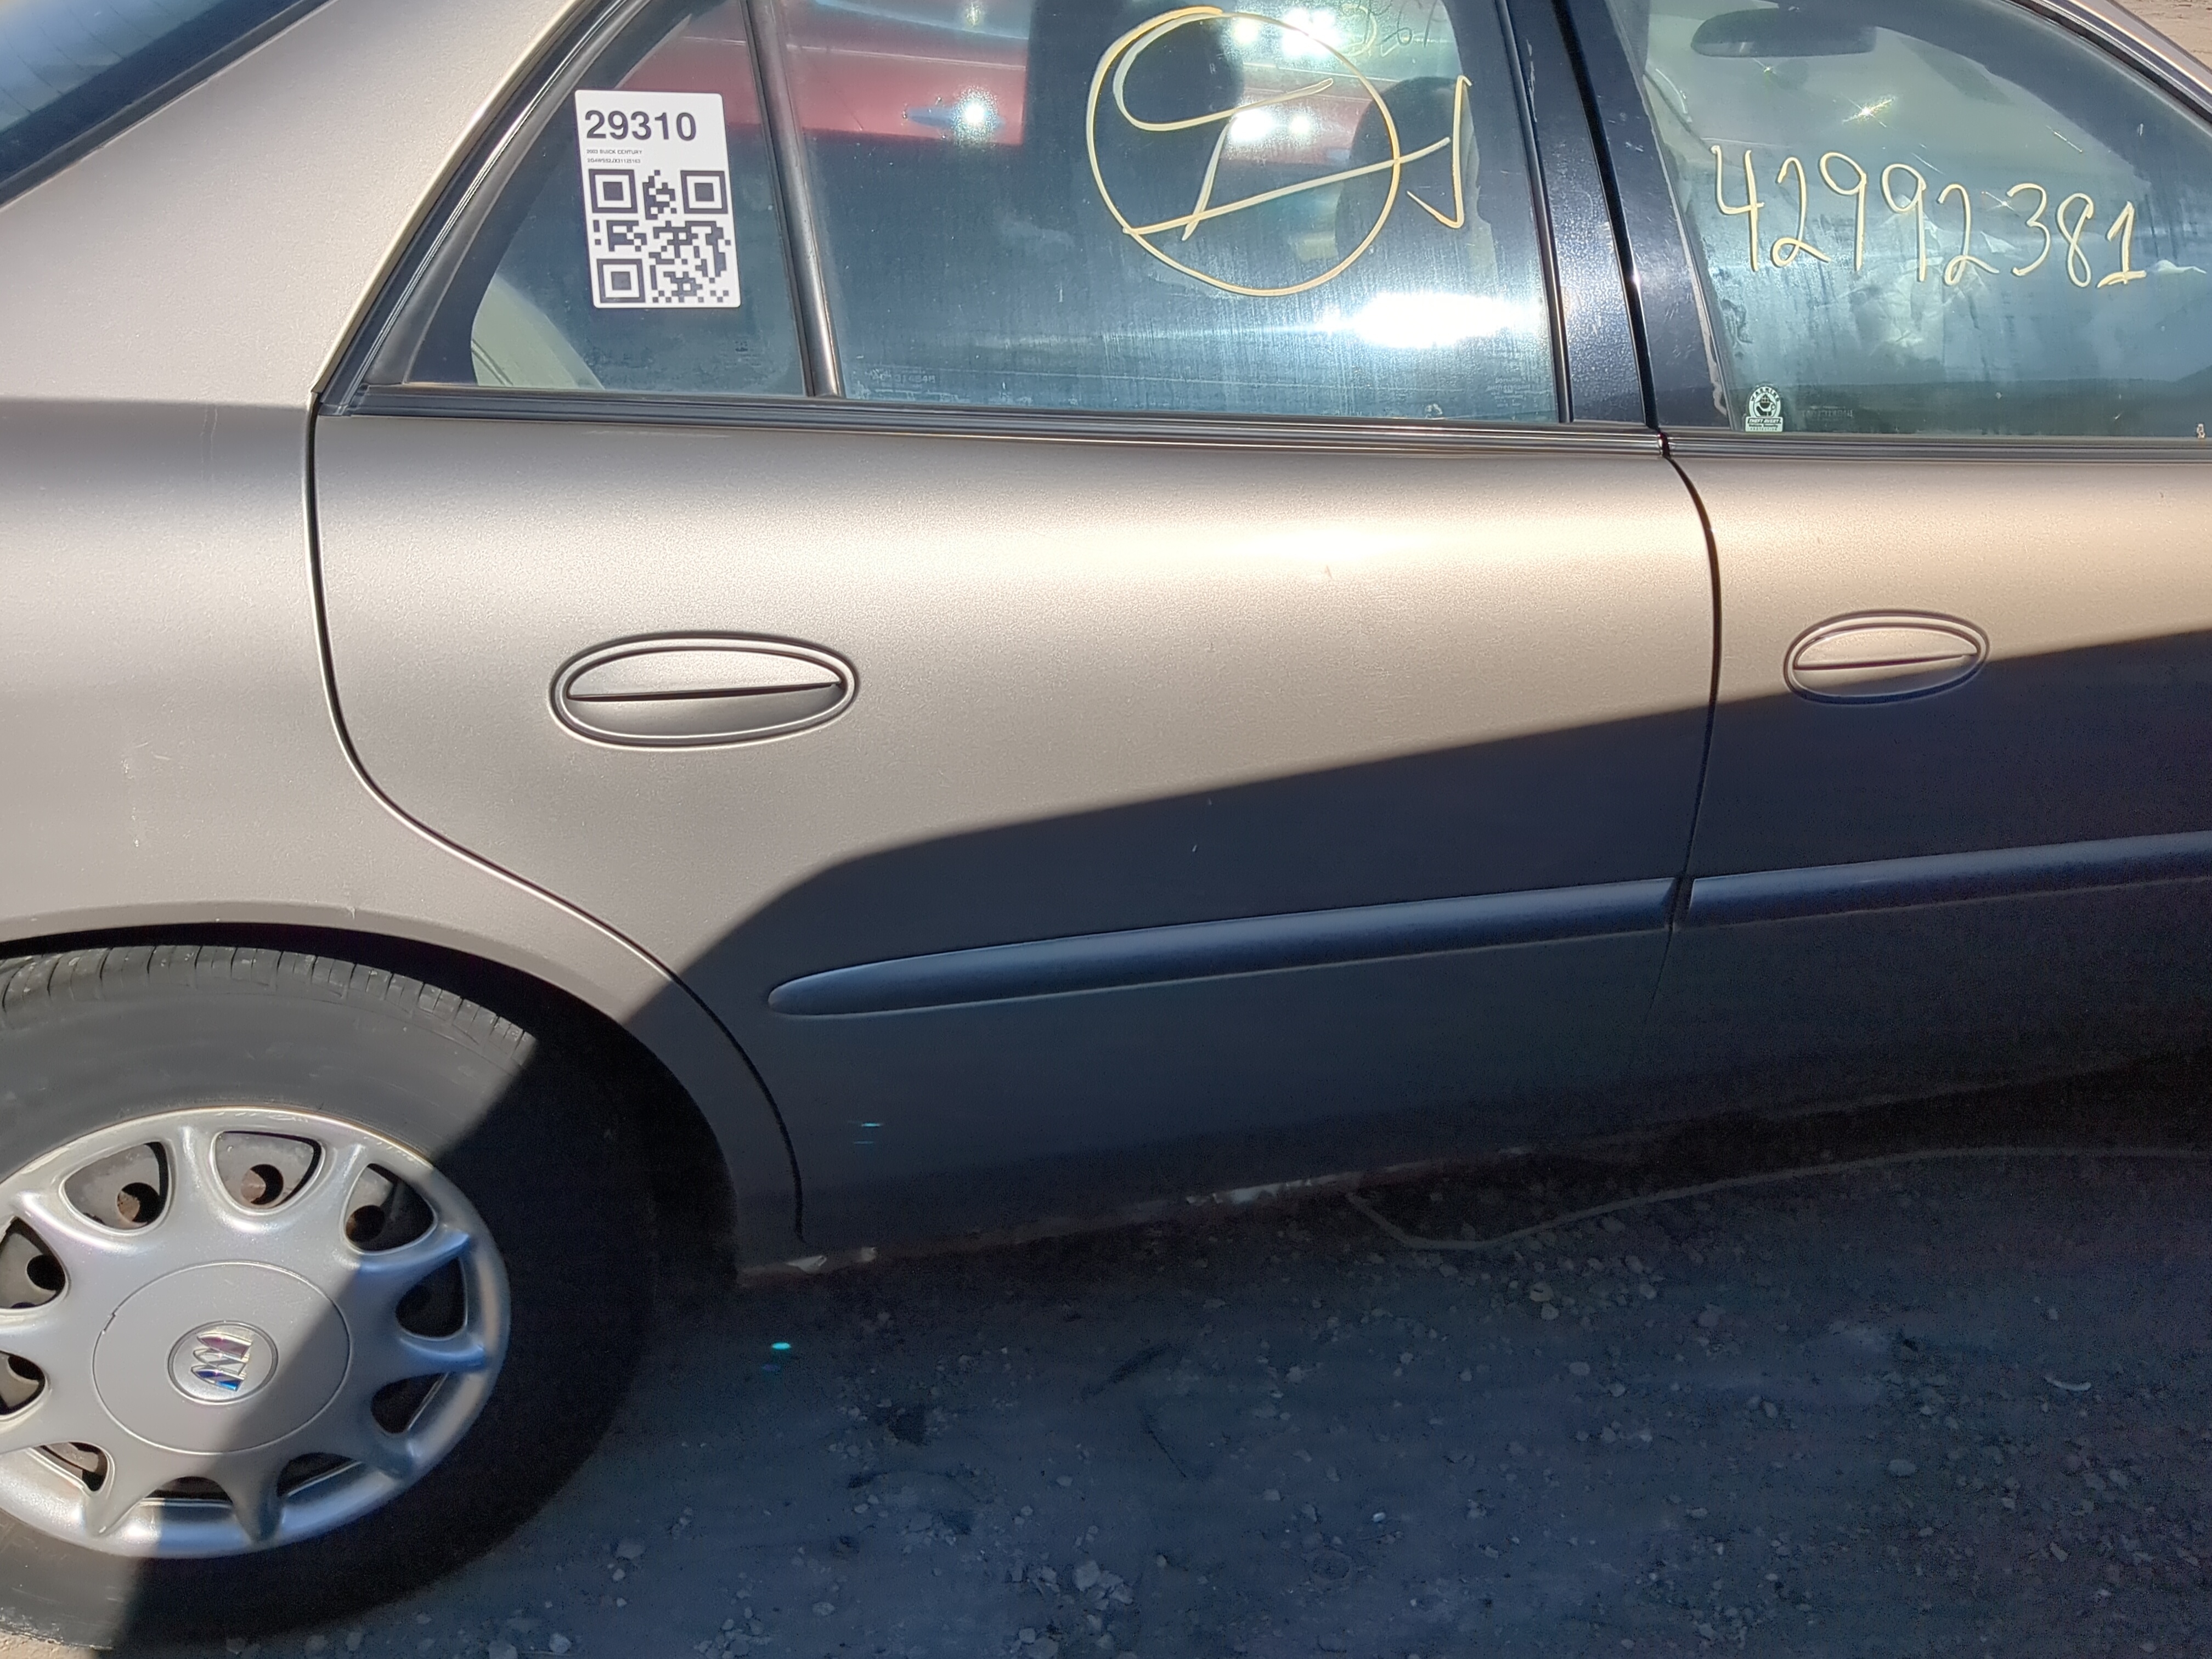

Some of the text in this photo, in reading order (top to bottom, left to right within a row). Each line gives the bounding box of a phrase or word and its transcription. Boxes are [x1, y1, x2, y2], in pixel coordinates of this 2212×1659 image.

[585, 110, 697, 141] 29310
[1710, 145, 2147, 288] 42992381
[1751, 387, 1780, 402] WARNING
